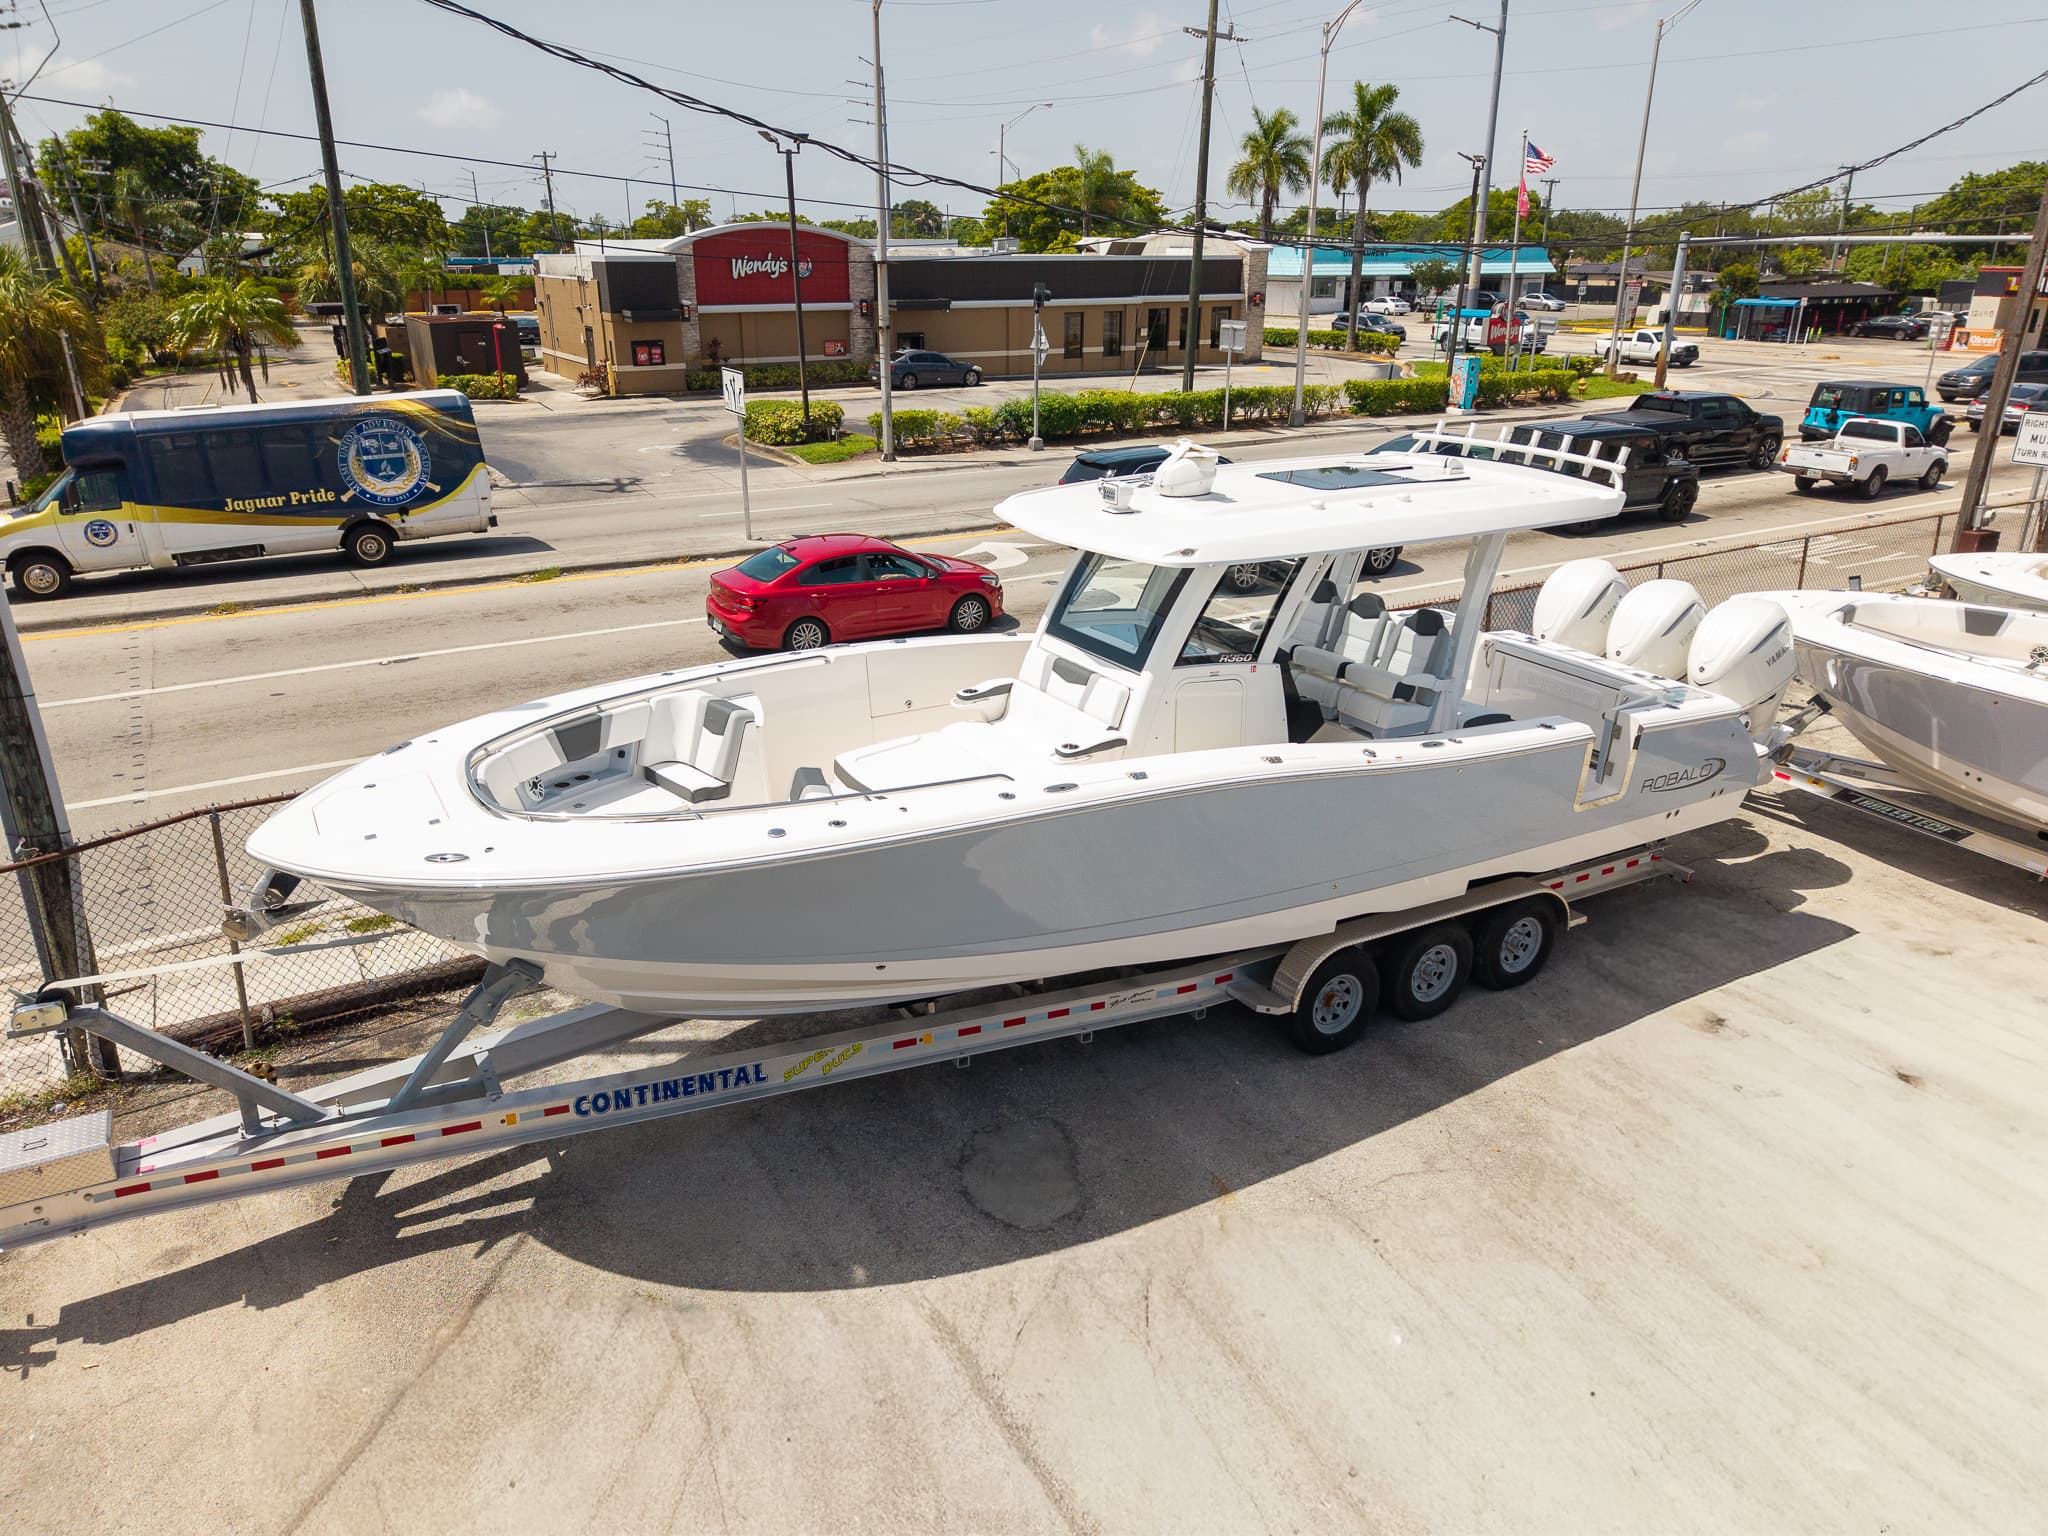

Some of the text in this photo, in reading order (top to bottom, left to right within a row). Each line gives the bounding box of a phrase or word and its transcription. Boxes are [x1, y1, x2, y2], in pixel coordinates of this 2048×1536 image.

[731, 252, 788, 279] Wendy's
[1490, 323, 1520, 340] Weny's
[340, 420, 430, 493] MIAMI UNION ADVENTIST ACADEMY
[2016, 448, 2038, 458] TURN
[224, 488, 336, 513] Jaguar Pride
[1640, 763, 1713, 793] ROBALO
[573, 1062, 769, 1117] CONTINENTAL
